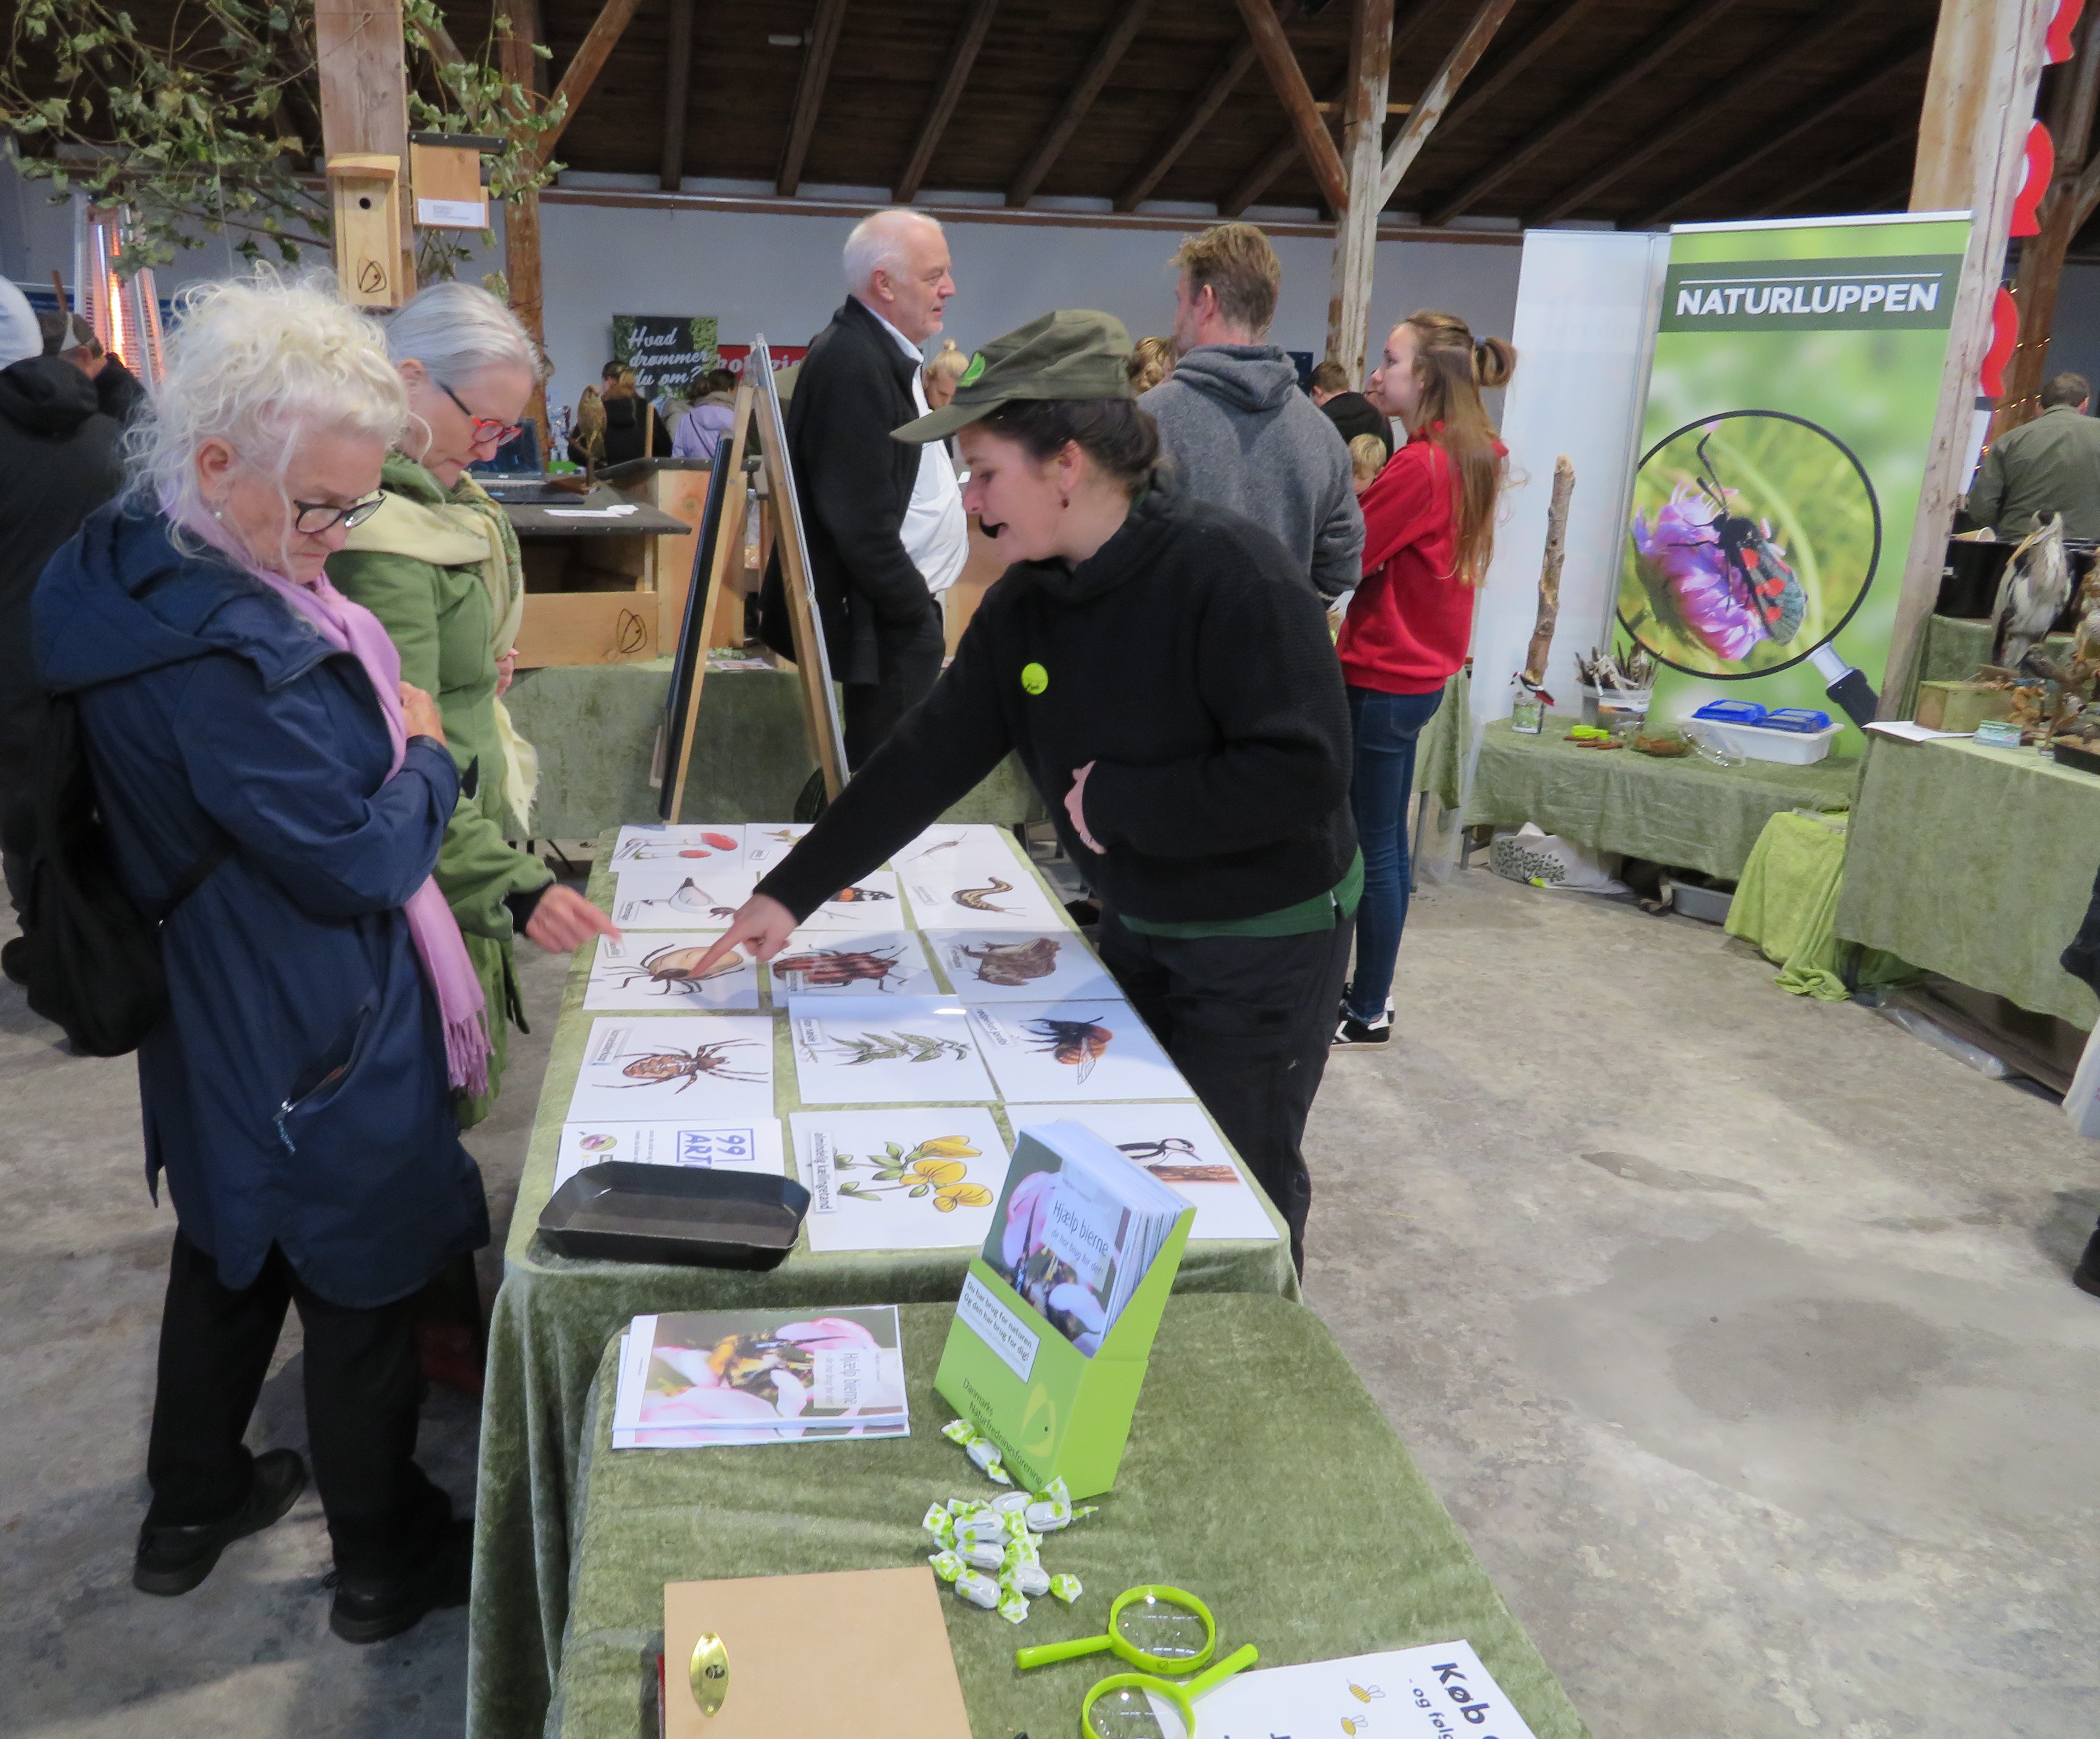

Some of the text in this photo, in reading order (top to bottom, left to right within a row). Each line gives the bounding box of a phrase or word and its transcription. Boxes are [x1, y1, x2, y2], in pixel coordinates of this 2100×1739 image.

[1676, 283, 1939, 316] NATURLUPPEN
[628, 325, 678, 348] Hvad
[634, 365, 703, 386] du om?
[683, 1132, 712, 1168] ART
[716, 1135, 746, 1155] 99
[1053, 1199, 1109, 1256] Hjælp bierne
[964, 1293, 972, 1307] Og
[972, 1302, 983, 1317] den
[983, 1311, 994, 1327] har
[993, 1321, 1007, 1342] brug
[1007, 1335, 1017, 1349] for
[967, 1281, 1033, 1350] Du har brug for naturen.
[963, 1377, 993, 1416] Danmarks
[969, 1401, 1043, 1485] Naturfredningsforening
[1413, 1688, 1432, 1708] og
[1431, 1662, 1490, 1724] Køb
